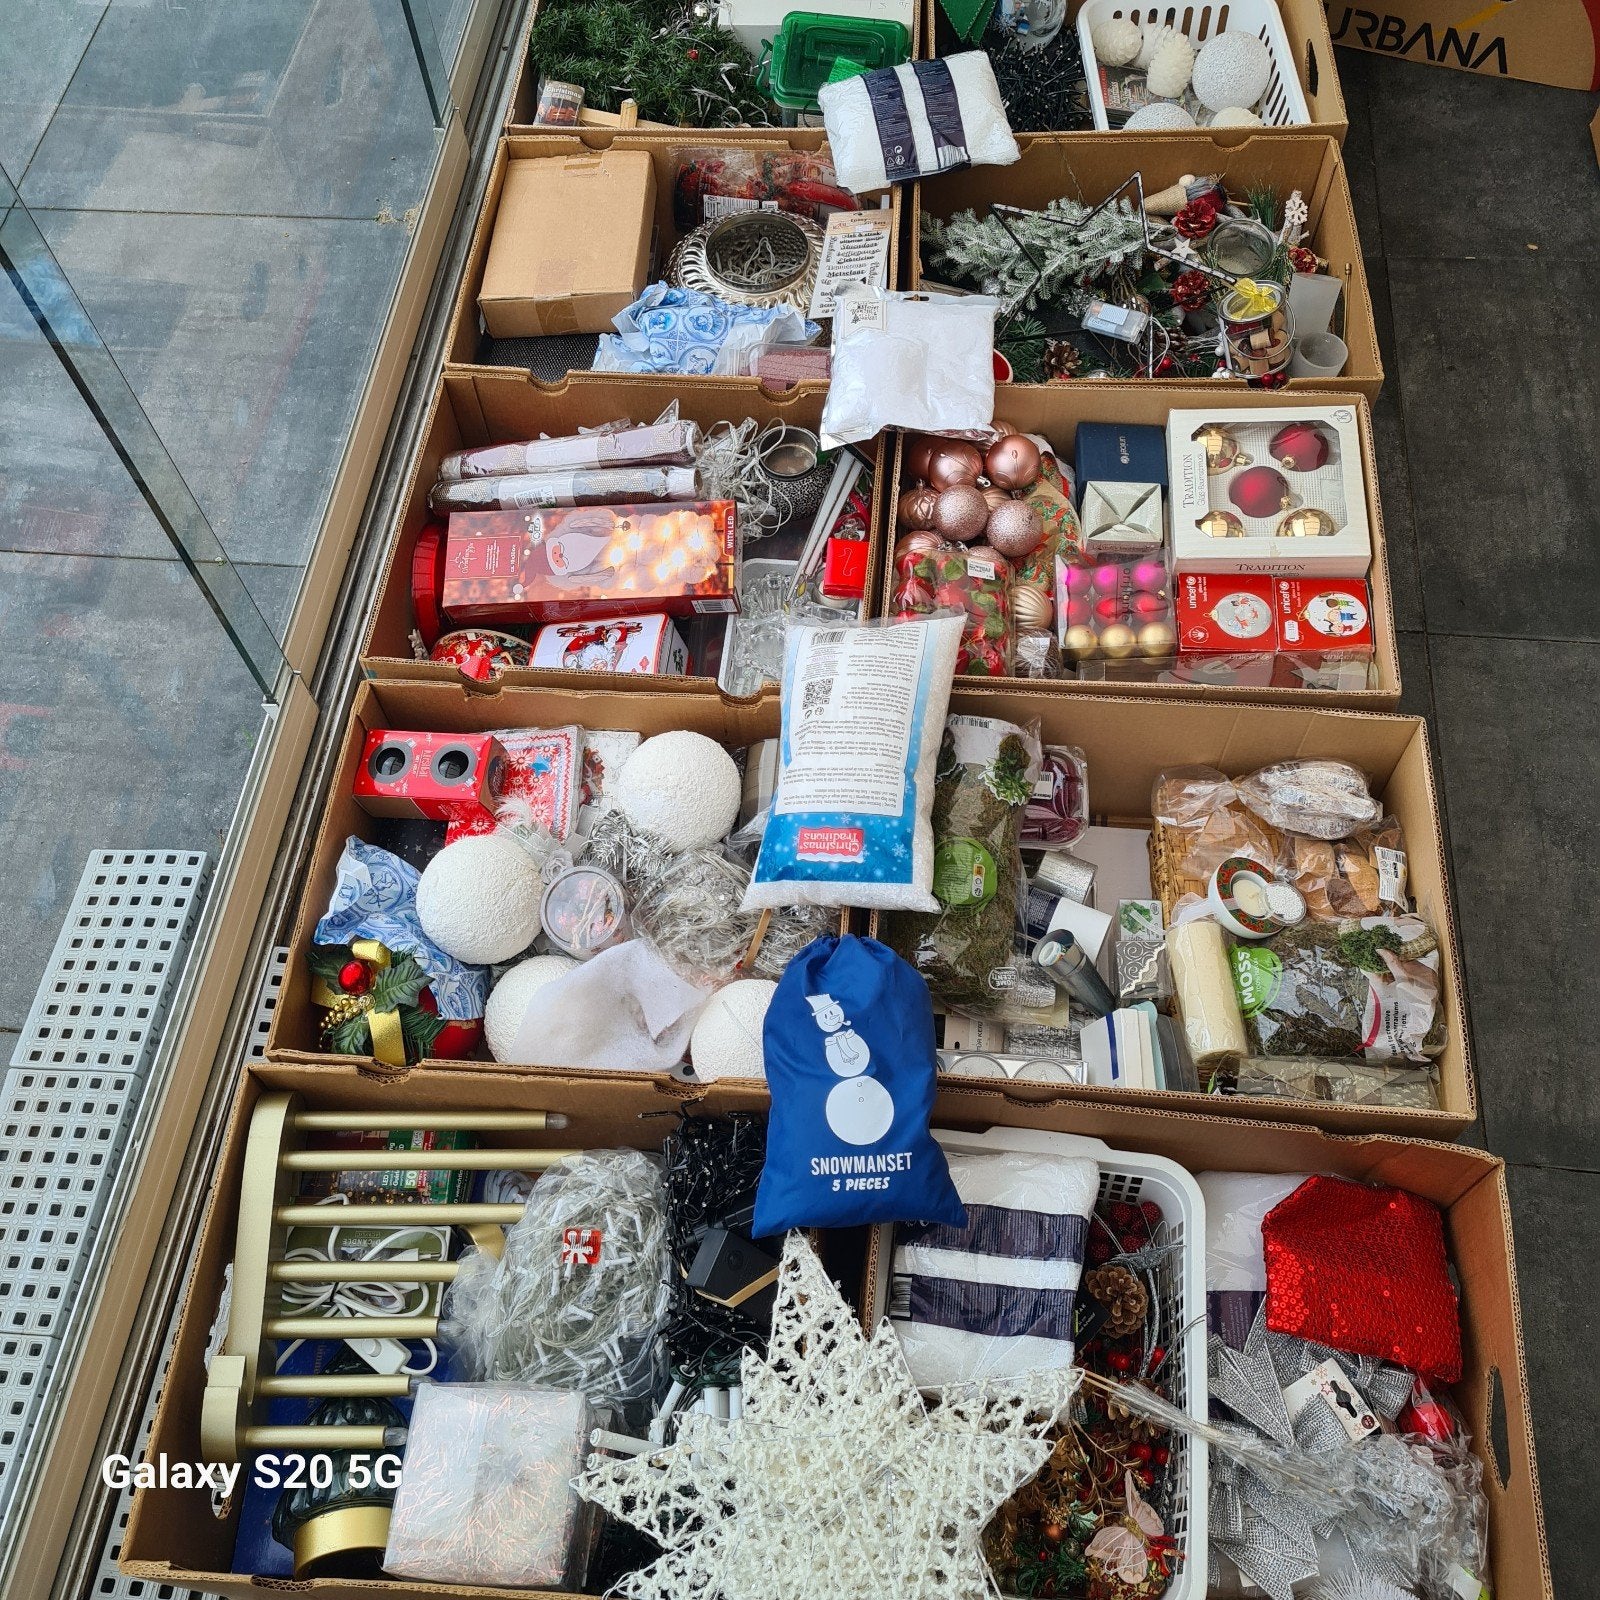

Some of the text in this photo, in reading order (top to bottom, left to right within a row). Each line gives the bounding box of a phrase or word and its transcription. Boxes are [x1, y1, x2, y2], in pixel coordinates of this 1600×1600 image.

[1323, 3, 1508, 74] URBANA
[1182, 453, 1195, 508] TRADITION
[726, 515, 735, 549] WITH LED
[1235, 563, 1306, 571] TRADITION
[1188, 584, 1198, 609] unicef
[1279, 589, 1291, 614] unicef
[803, 841, 860, 853] Christmas
[804, 832, 858, 842] Traditions
[1237, 951, 1256, 1005] MOSS
[811, 1152, 912, 1176] SNOWMANSET
[405, 1170, 417, 1187] 50
[832, 1177, 890, 1191] 5 PIECES
[342, 1238, 373, 1246] CANDLE
